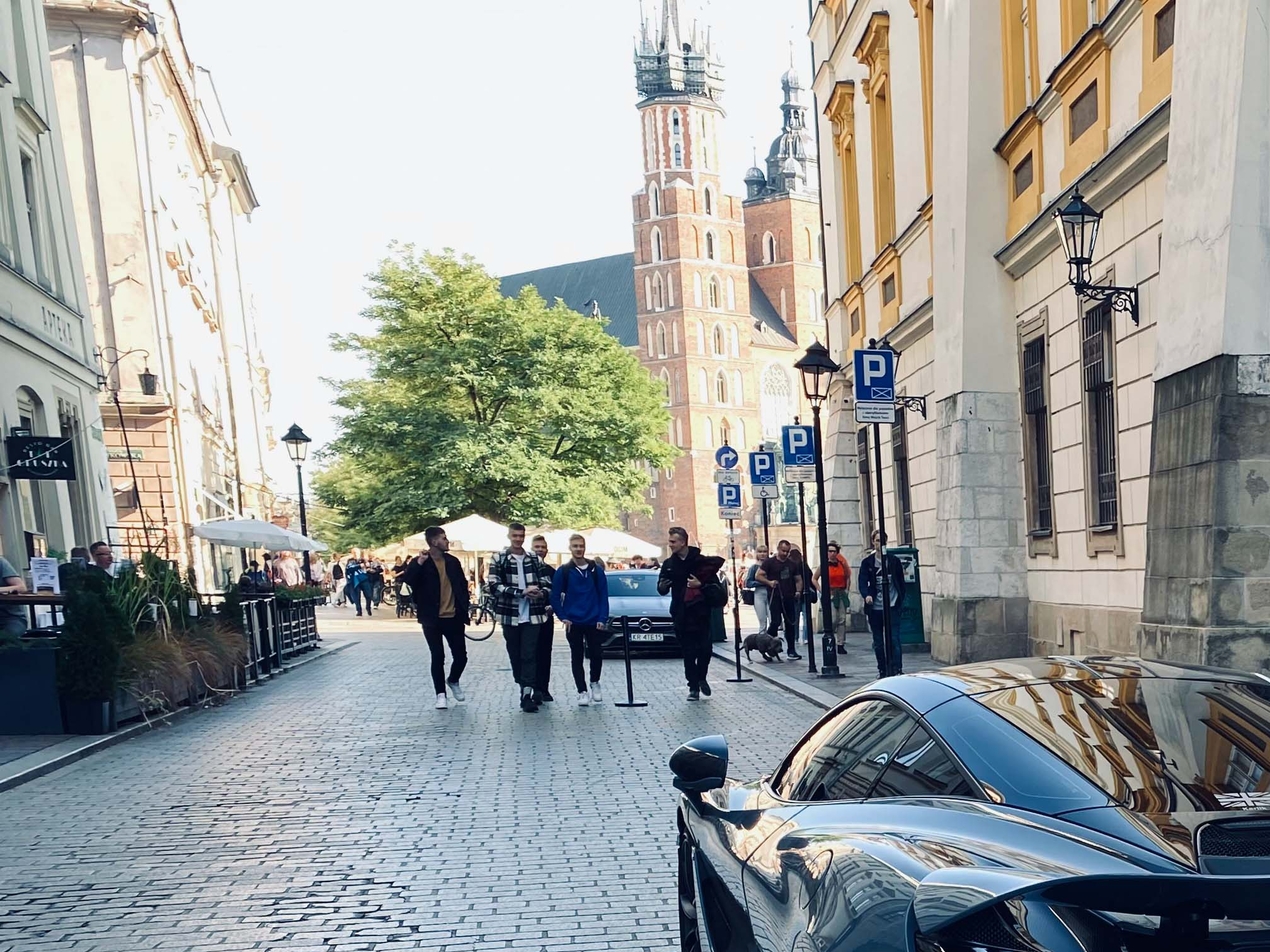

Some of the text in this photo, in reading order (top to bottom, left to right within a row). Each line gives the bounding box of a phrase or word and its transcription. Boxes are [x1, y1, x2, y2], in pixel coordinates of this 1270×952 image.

[41, 306, 75, 348] APTEKA
[863, 354, 887, 387] P
[788, 428, 808, 454] P
[754, 454, 770, 476] P
[722, 486, 736, 505] P
